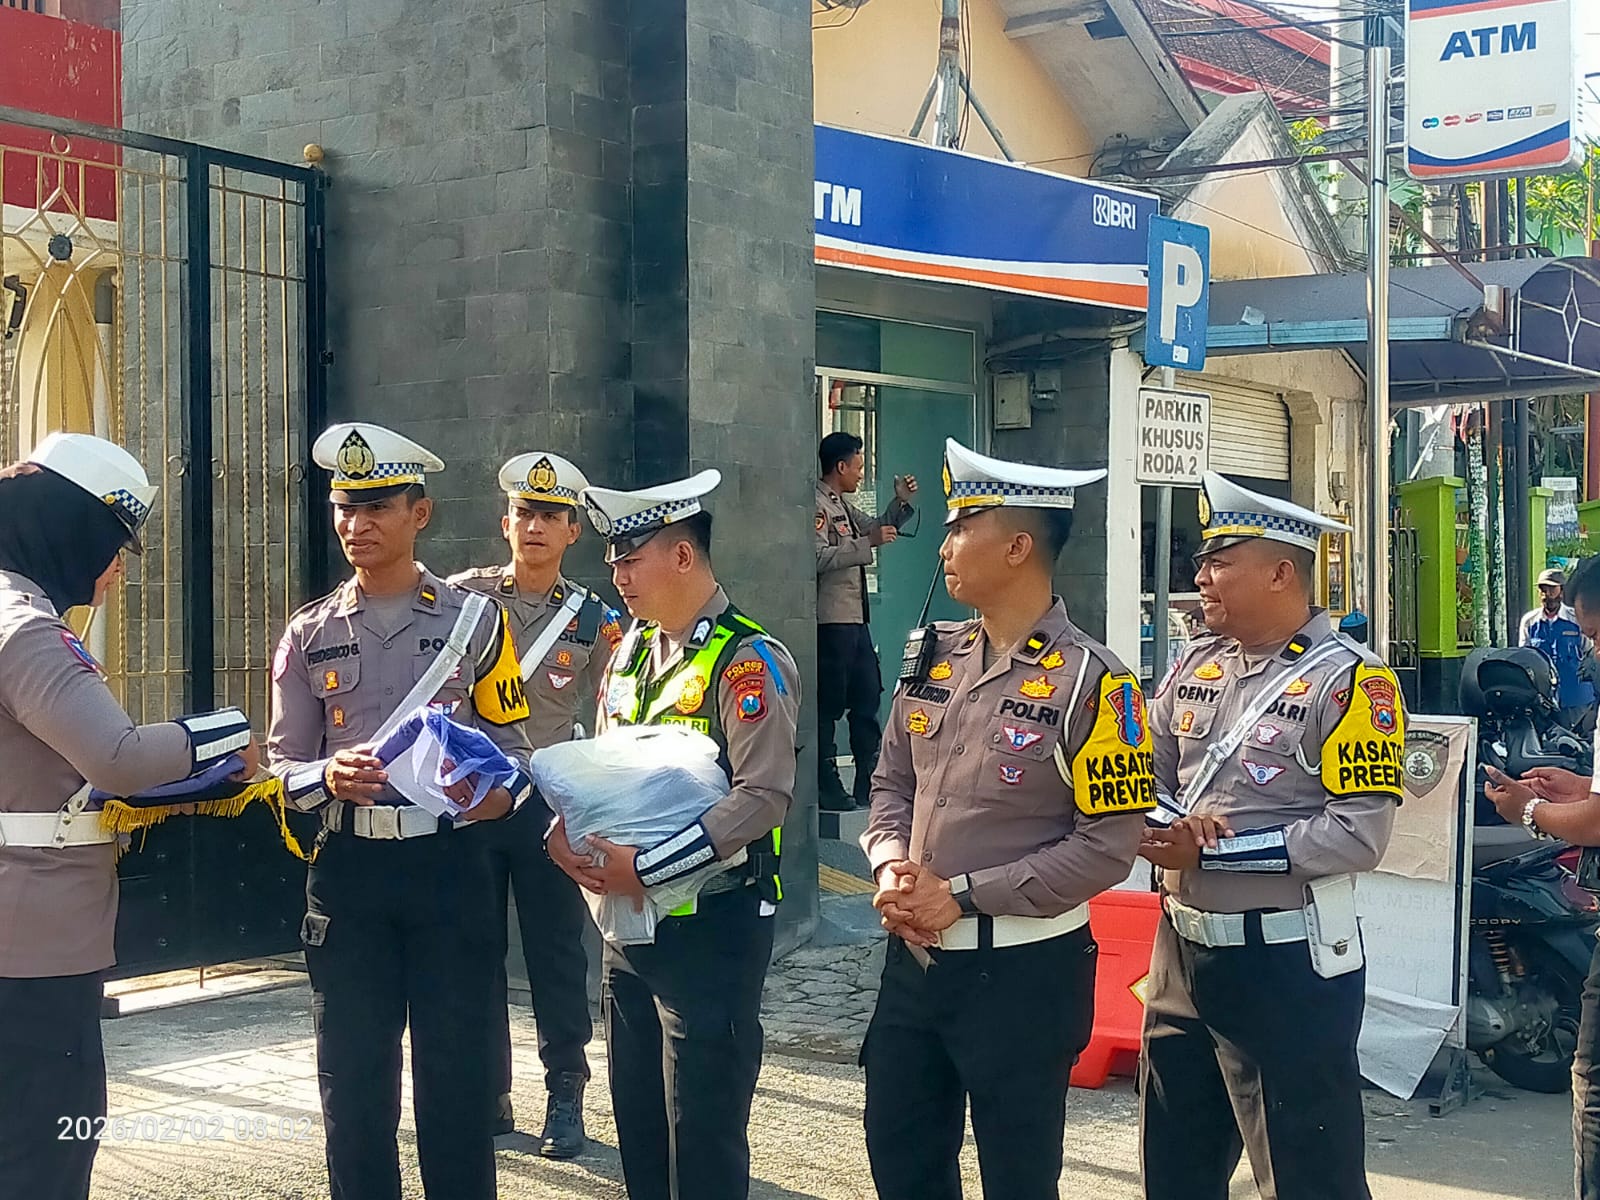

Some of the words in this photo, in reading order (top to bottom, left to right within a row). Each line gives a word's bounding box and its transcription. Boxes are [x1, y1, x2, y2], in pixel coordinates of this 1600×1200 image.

[1440, 22, 1537, 62] ATM
[814, 180, 862, 226] TM
[1110, 199, 1136, 230] BRI
[1160, 240, 1204, 343] P
[1144, 398, 1203, 424] PARKIR
[1141, 426, 1204, 451] KHUSUS
[1143, 452, 1185, 475] RODA
[1188, 455, 1198, 476] 2
[1177, 685, 1220, 703] DENY
[1000, 698, 1060, 726] POLRI
[1264, 702, 1307, 722] OLRI
